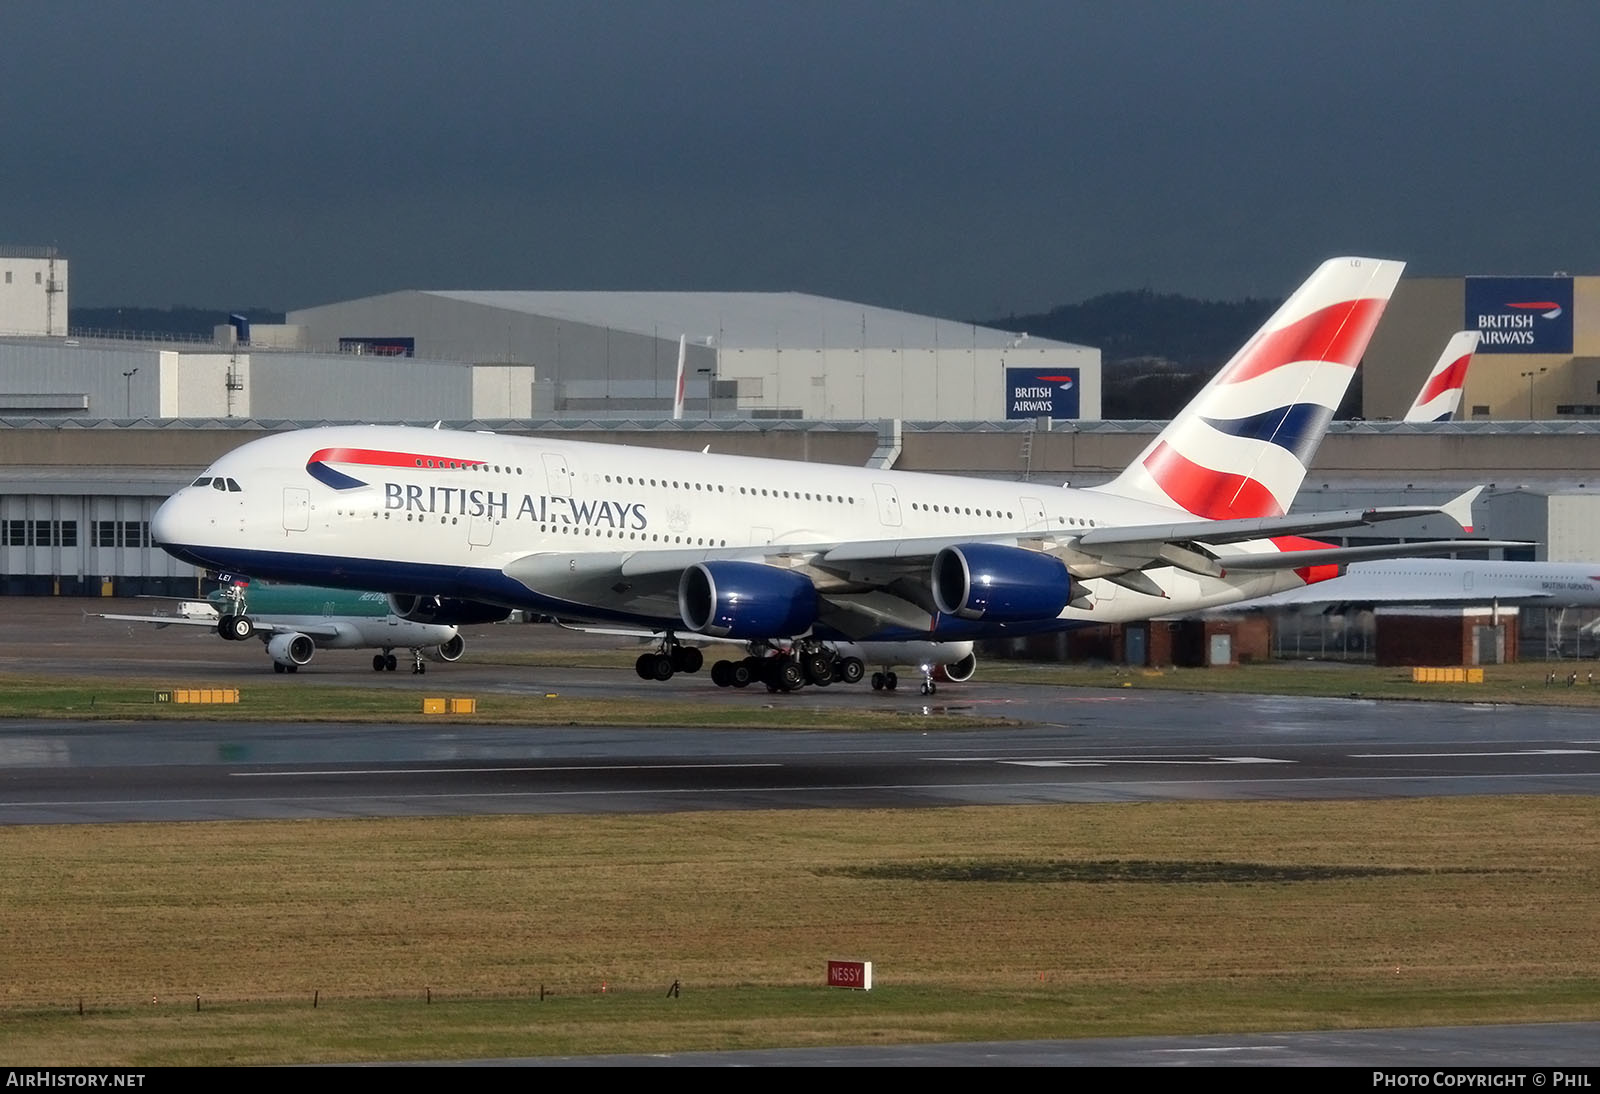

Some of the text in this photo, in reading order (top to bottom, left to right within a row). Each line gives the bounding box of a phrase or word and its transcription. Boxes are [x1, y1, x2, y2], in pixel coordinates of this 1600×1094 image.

[1478, 314, 1534, 328] BRITISH
[1015, 387, 1052, 398] BRITISH
[1013, 401, 1053, 412] AIRWAYS
[384, 483, 648, 530] BRITISH AIRWAYS
[218, 573, 232, 582] LEI
[158, 693, 169, 702] N1
[831, 967, 861, 982] NESSY
